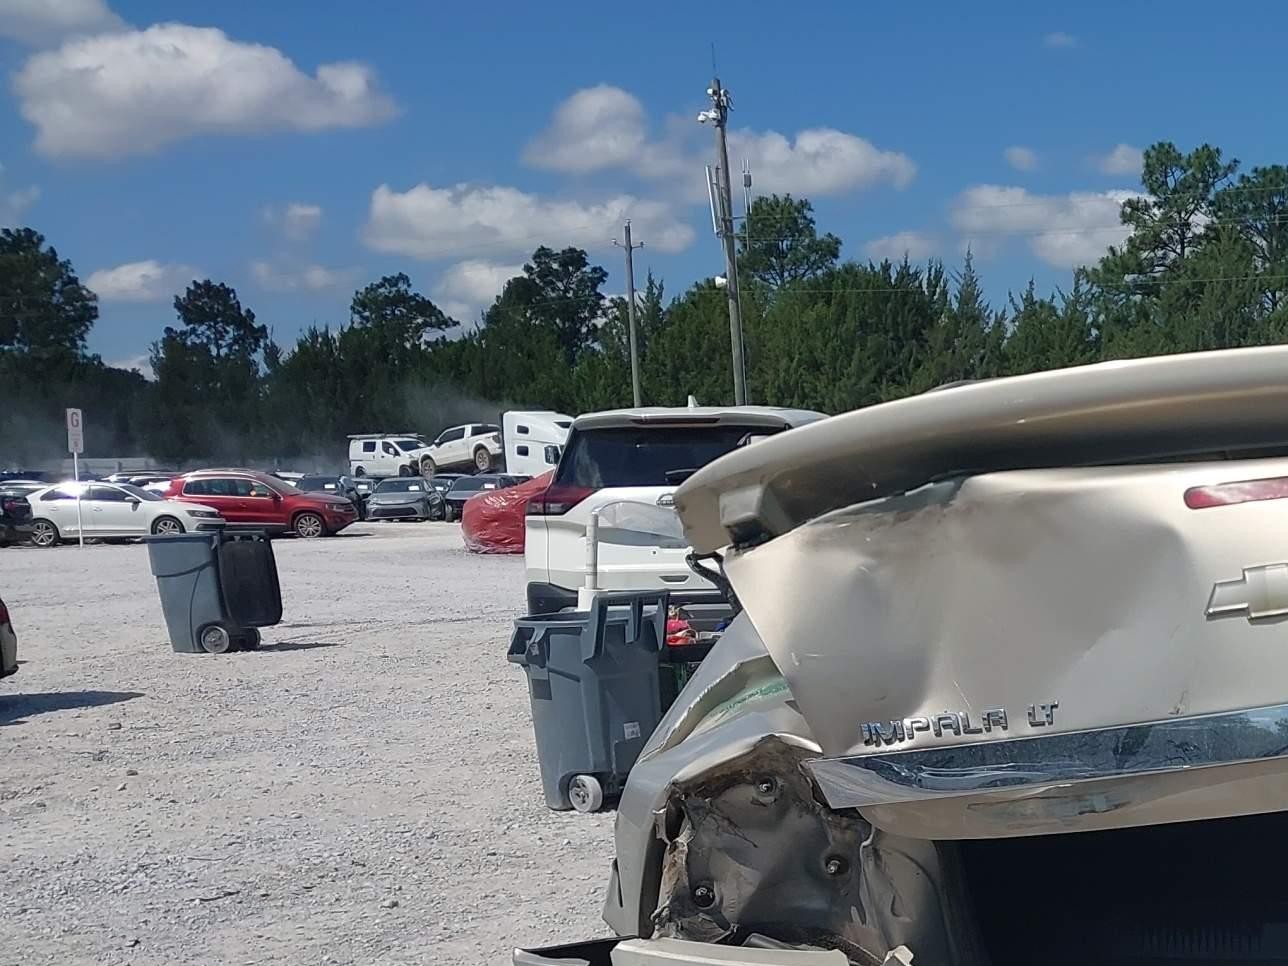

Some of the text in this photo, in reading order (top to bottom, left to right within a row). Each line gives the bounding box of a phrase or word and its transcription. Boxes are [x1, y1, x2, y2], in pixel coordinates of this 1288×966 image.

[71, 411, 80, 428] G
[860, 700, 1059, 747] IMPALA LT
